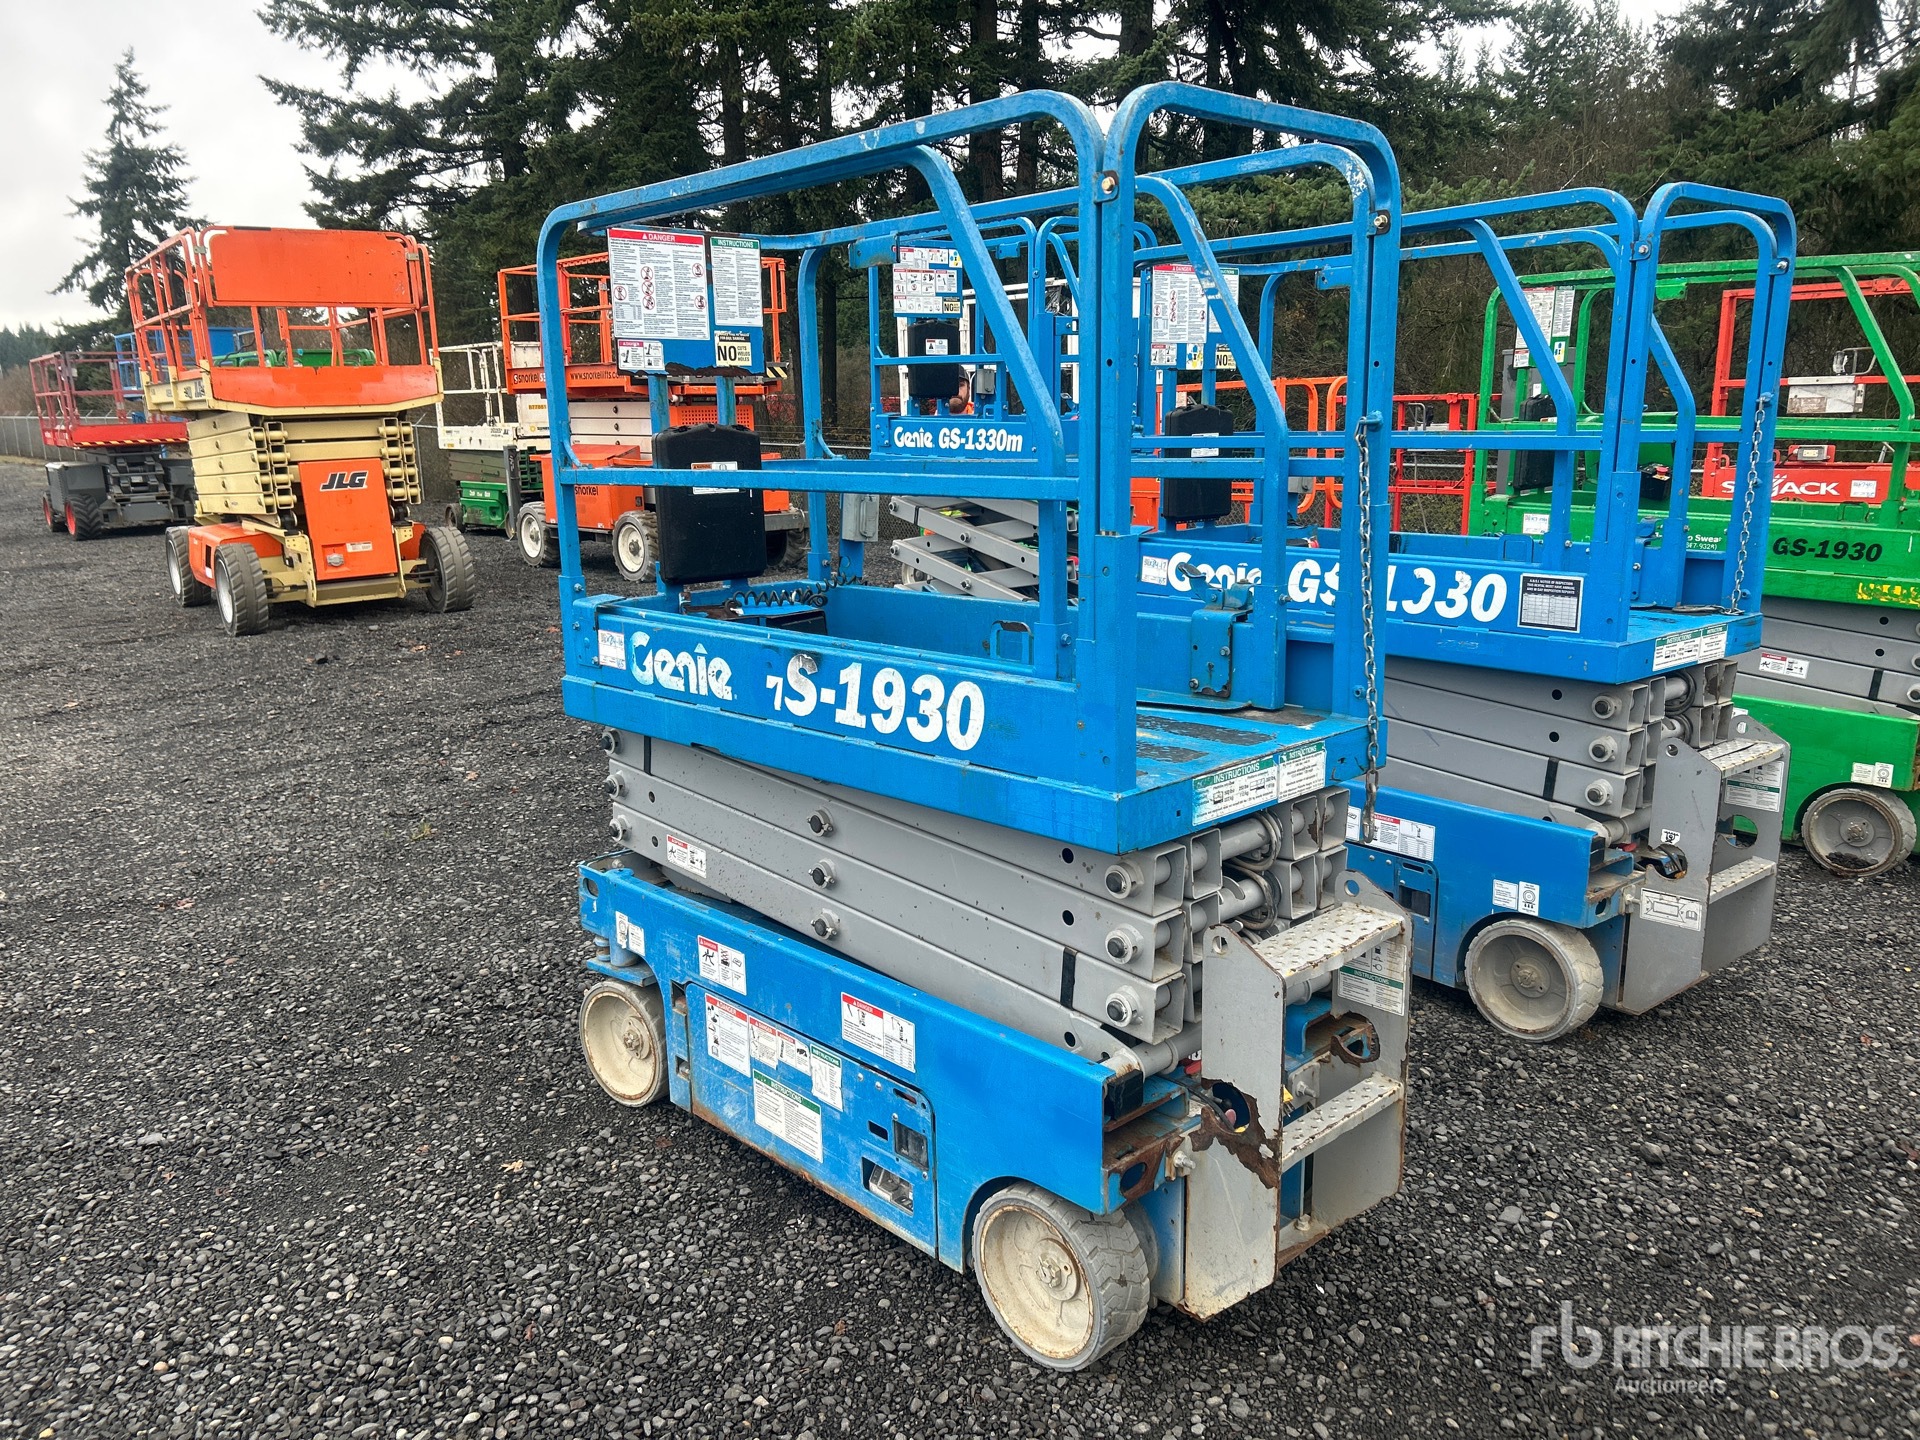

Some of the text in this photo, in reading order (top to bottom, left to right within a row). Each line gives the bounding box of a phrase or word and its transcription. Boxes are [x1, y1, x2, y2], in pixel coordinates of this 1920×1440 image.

[648, 234, 676, 242] DANGER
[717, 239, 754, 248] INSTRUCTIONS
[717, 345, 737, 362] NO
[1216, 354, 1228, 366] NO
[893, 426, 1023, 452] Genie GS-1330m
[321, 471, 368, 490] JLG
[574, 485, 599, 496] snorkel
[1772, 537, 1883, 562] GS-1930
[1666, 633, 1692, 644] INSTRUCTIONS
[630, 631, 733, 700] Genie
[1213, 763, 1260, 783] INSTRUCTIONS
[1353, 970, 1390, 985] INSTRUCTIONS
[857, 1001, 874, 1013] DANGER
[812, 1048, 840, 1066] INSTRUCTIONS
[770, 1080, 802, 1104] INSTRUCTIONS
